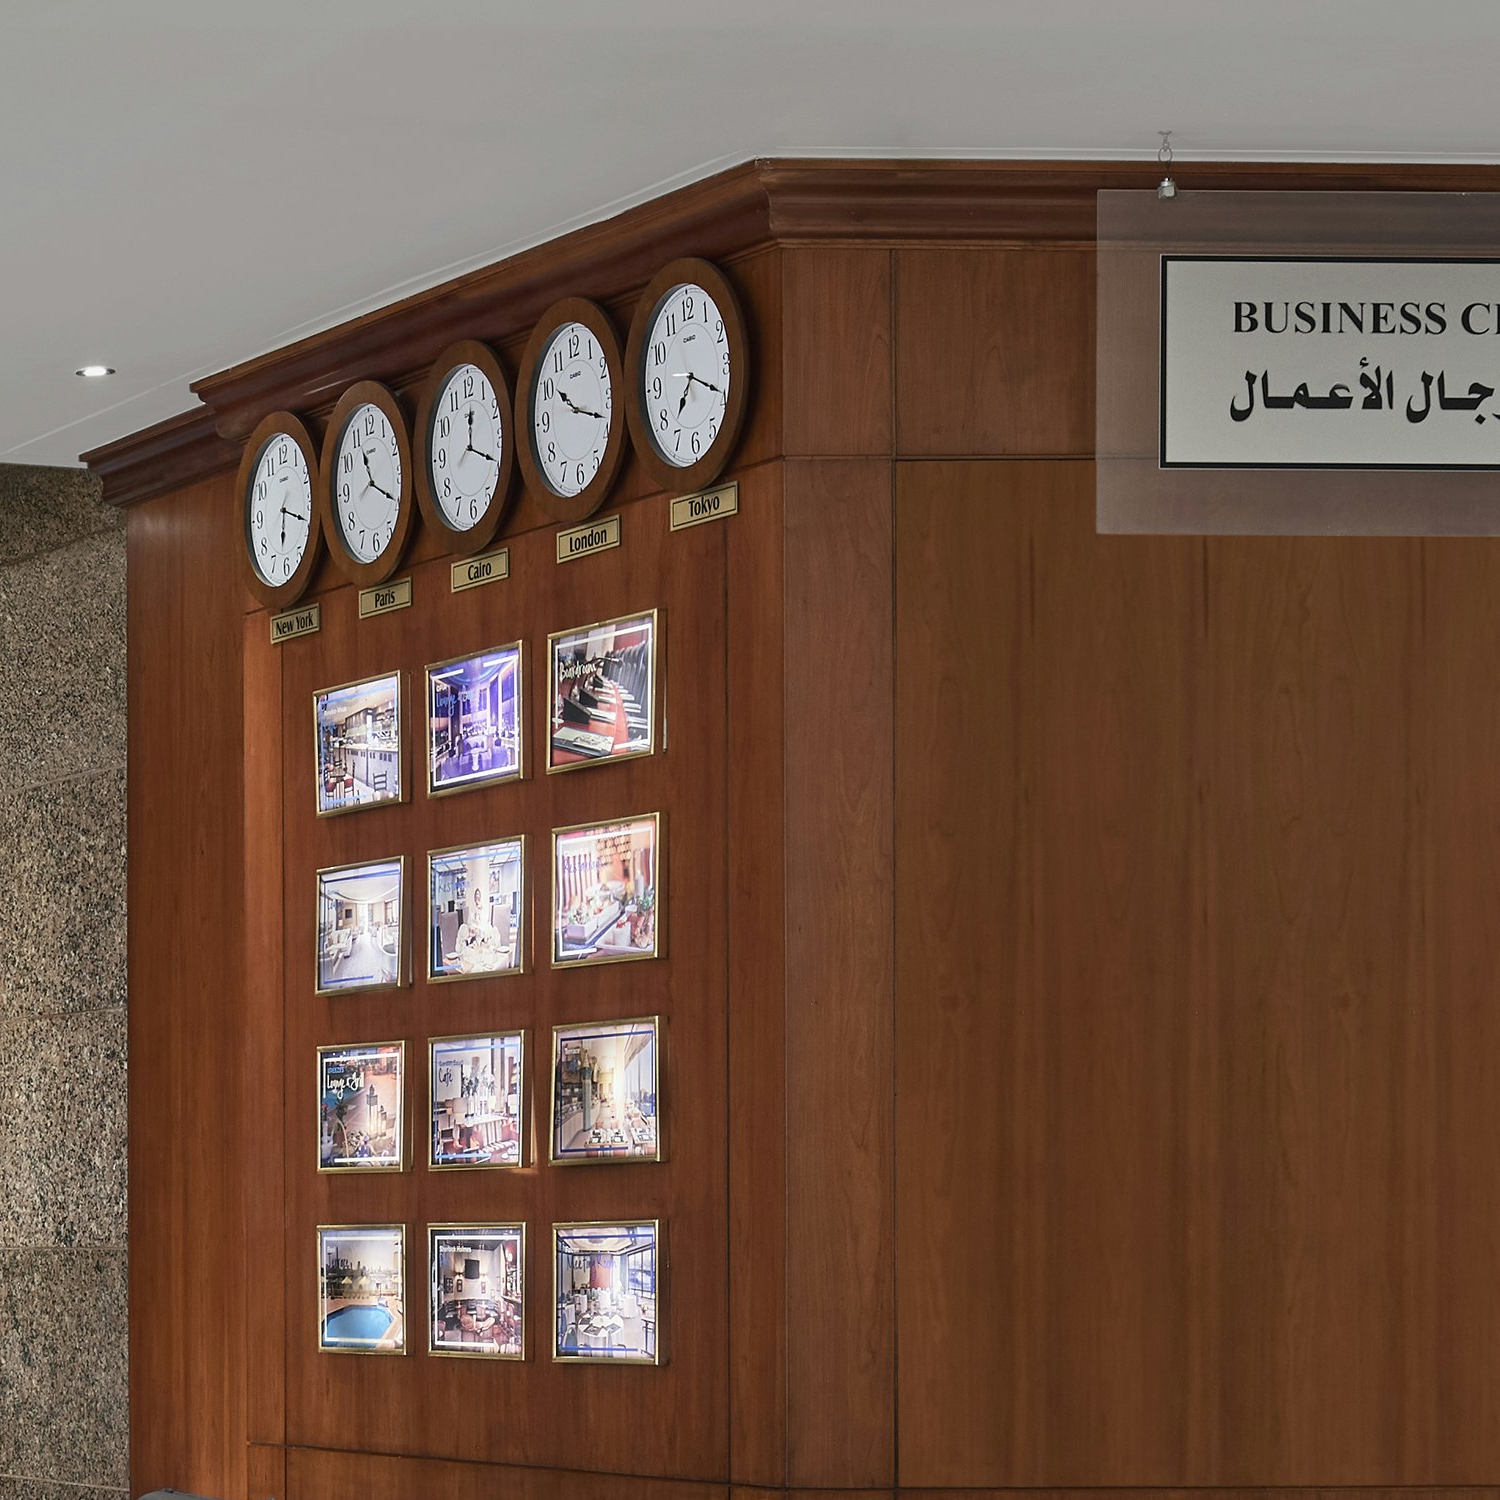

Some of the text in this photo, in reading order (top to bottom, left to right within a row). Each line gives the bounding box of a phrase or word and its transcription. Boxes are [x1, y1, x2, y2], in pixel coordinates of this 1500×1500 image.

[681, 296, 694, 322] 12
[1232, 301, 1447, 336] BUSINESS
[665, 313, 676, 337] 11
[716, 319, 724, 344] 2
[568, 334, 580, 359] 12
[683, 334, 696, 343] CASIO
[553, 350, 563, 373] 11
[654, 341, 666, 366] 10
[599, 356, 607, 380] 2
[463, 375, 474, 399] 12
[542, 377, 554, 401] 10
[653, 376, 662, 400] 9
[1229, 356, 1394, 423] الأعمال
[450, 390, 459, 412] 11
[364, 414, 375, 437] 12
[439, 415, 450, 438] 10
[541, 411, 550, 433] 9
[660, 408, 669, 430] 8
[708, 417, 717, 440] 5
[352, 428, 361, 449] 11
[673, 429, 681, 452] 7
[691, 431, 701, 455] 6
[278, 444, 288, 466] 12
[343, 452, 353, 473] 10
[438, 448, 446, 469] 9
[547, 441, 556, 463] 8
[266, 458, 275, 477] 11
[560, 461, 568, 483] 7
[576, 463, 585, 485] 6
[256, 480, 267, 501] 10
[342, 483, 350, 503] 9
[443, 477, 451, 498] 8
[455, 496, 462, 517] 7
[469, 499, 478, 520] 6
[688, 494, 720, 518] Tokyo
[257, 510, 263, 529] 9
[348, 511, 355, 531] 8
[261, 537, 268, 556] 8
[359, 530, 366, 550] 7
[372, 532, 380, 552] 6
[569, 528, 607, 553] London
[270, 555, 277, 574] 7
[283, 557, 290, 577] 6
[468, 558, 492, 581] Cairo
[374, 589, 395, 609] Paris
[276, 612, 313, 636] New York
